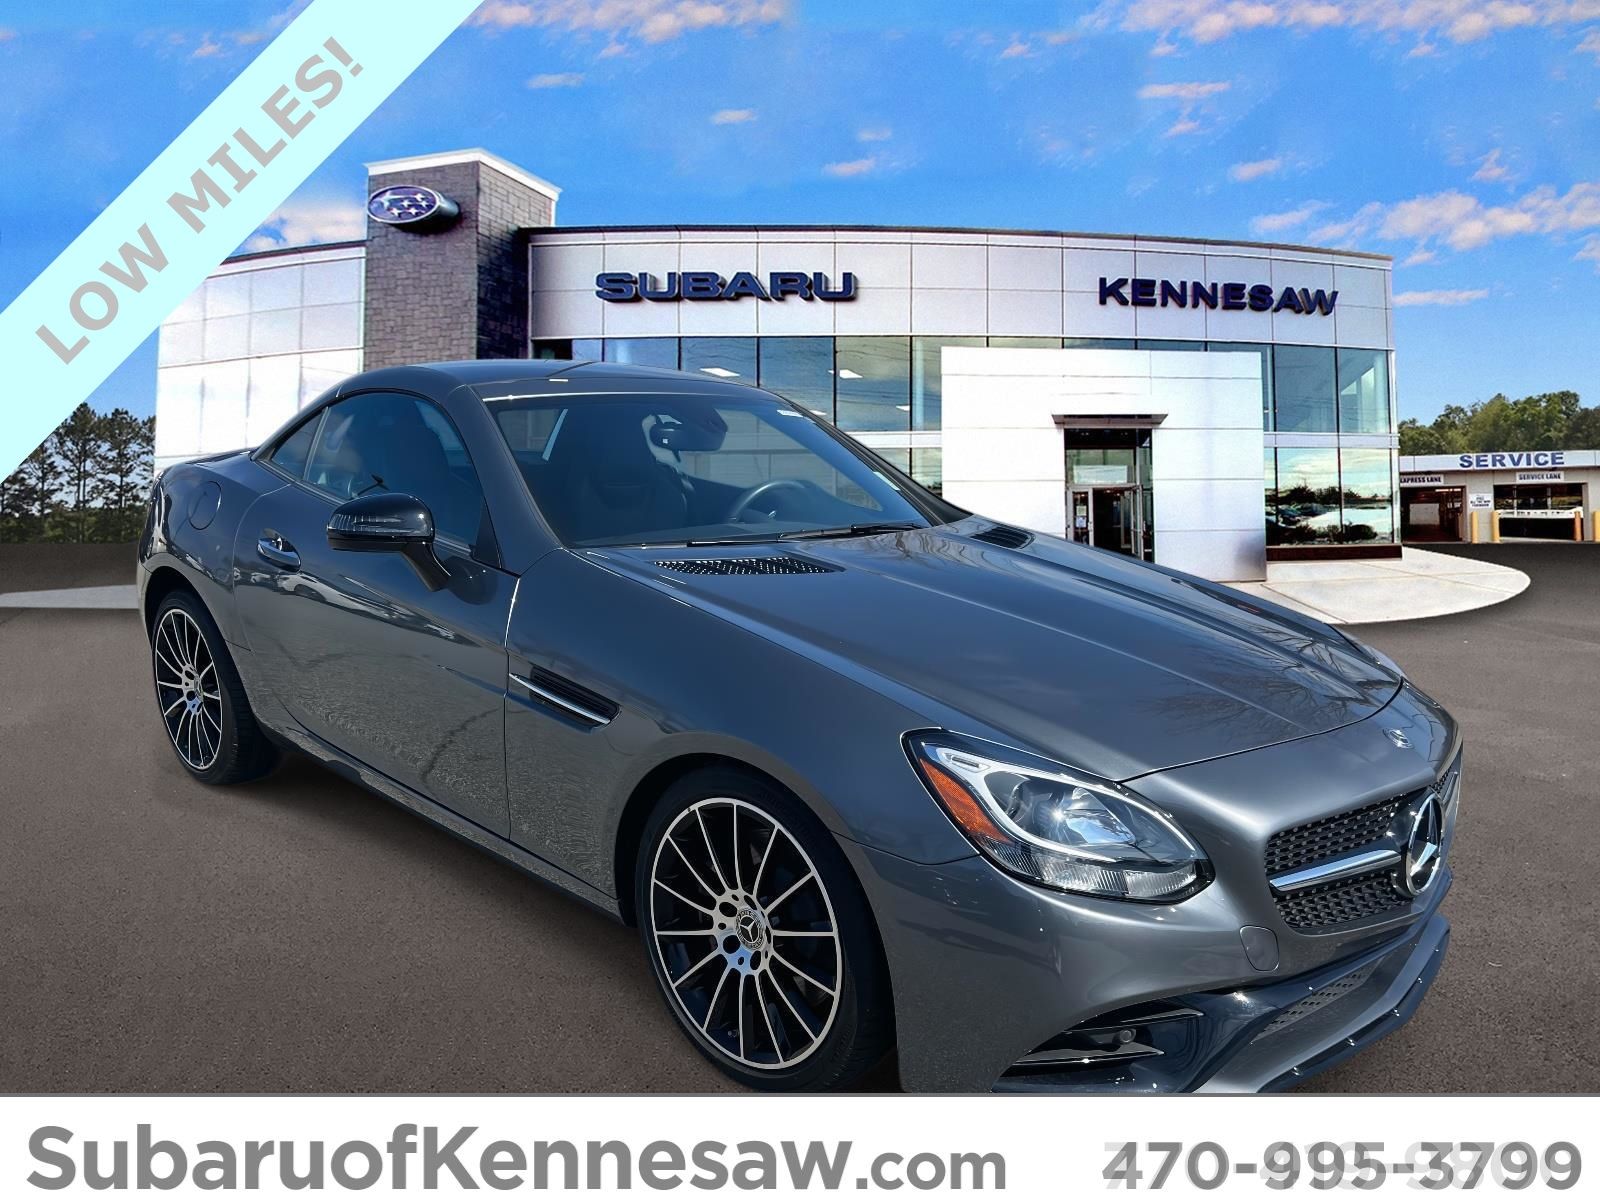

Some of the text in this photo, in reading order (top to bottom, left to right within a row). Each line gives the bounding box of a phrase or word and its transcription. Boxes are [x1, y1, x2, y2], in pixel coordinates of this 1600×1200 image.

[595, 270, 858, 303] SUBARU
[1098, 276, 1339, 316] KENNESAW
[1459, 452, 1565, 469] SERVICE
[1518, 472, 1562, 481] SERVICE LANE
